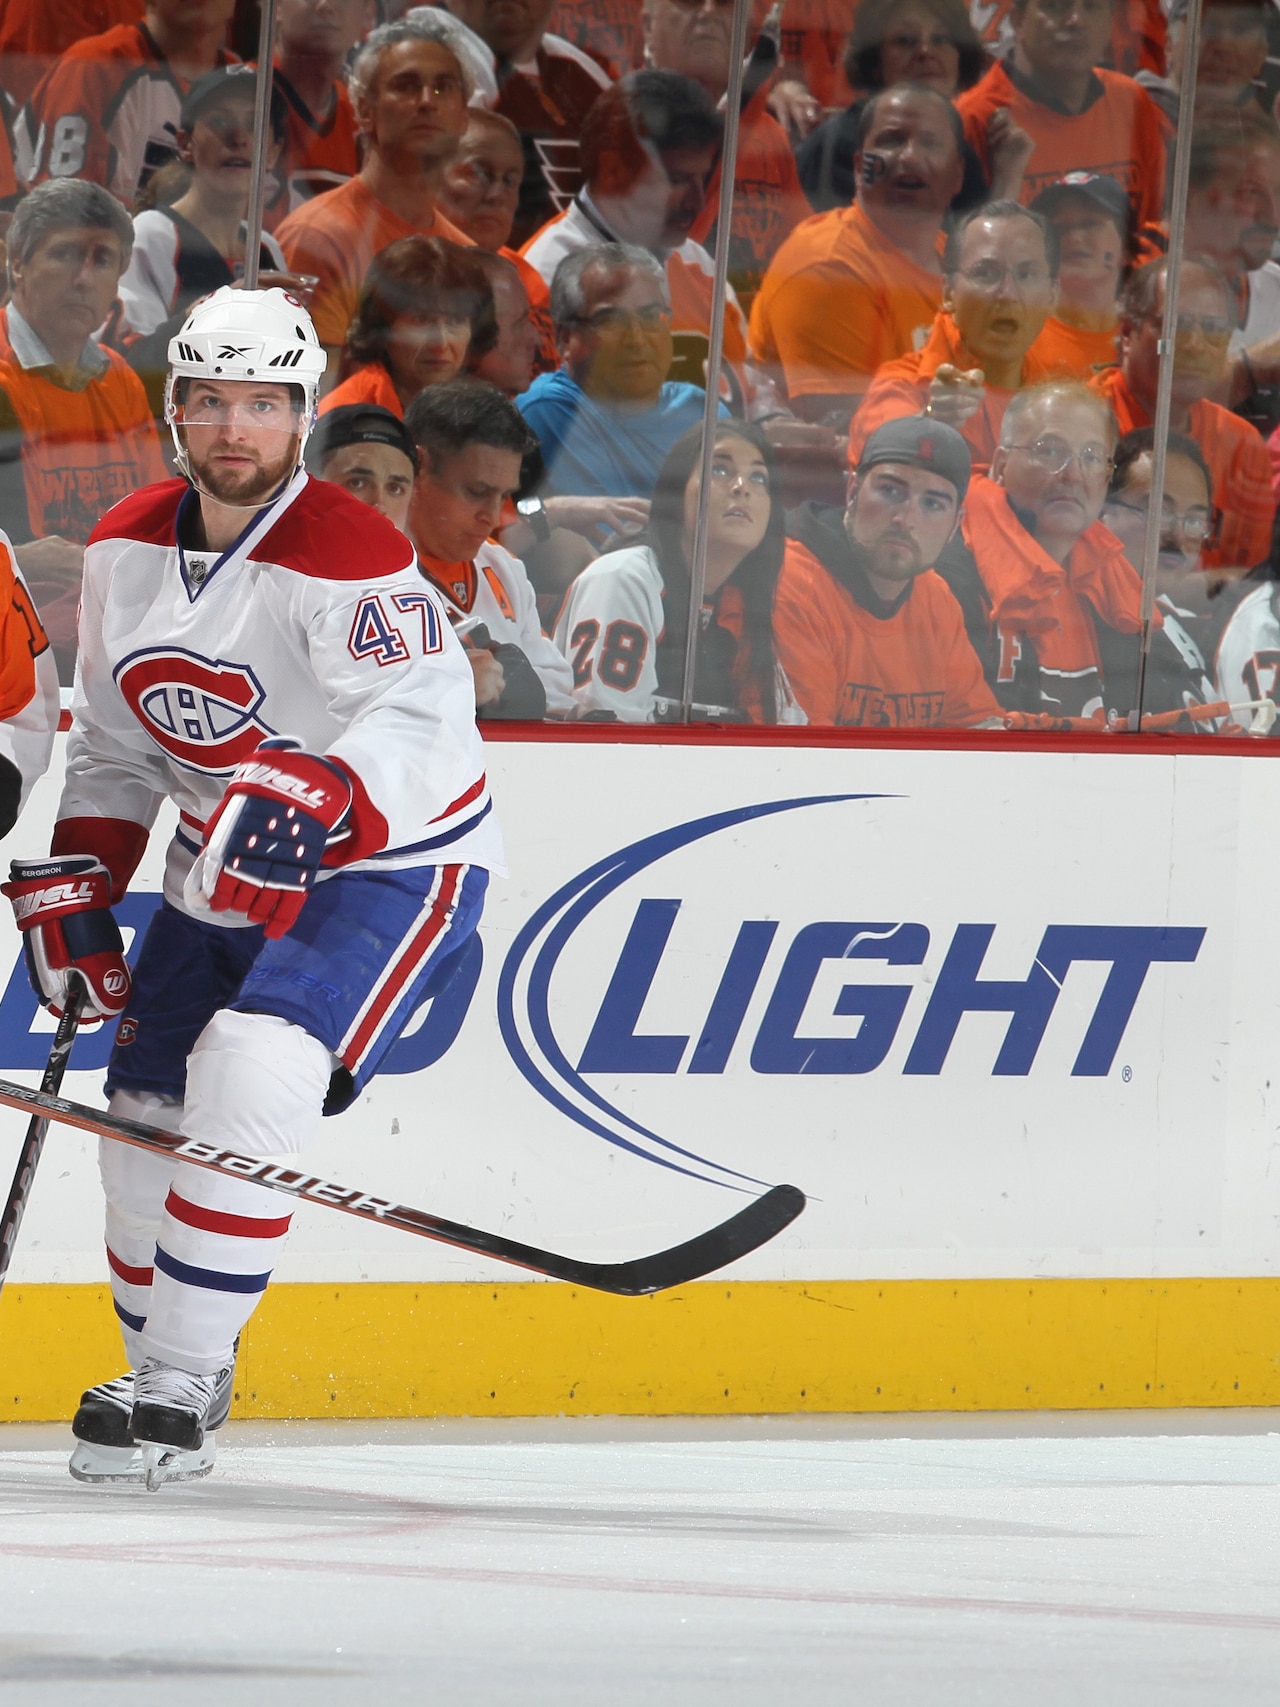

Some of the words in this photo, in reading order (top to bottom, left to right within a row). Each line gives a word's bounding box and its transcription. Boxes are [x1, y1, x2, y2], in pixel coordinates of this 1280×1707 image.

[348, 592, 444, 668] 47
[570, 618, 649, 693] 28
[21, 866, 62, 878] BERGERON
[576, 898, 1209, 1077] LIGHT
[174, 1139, 401, 1218] BAUER
